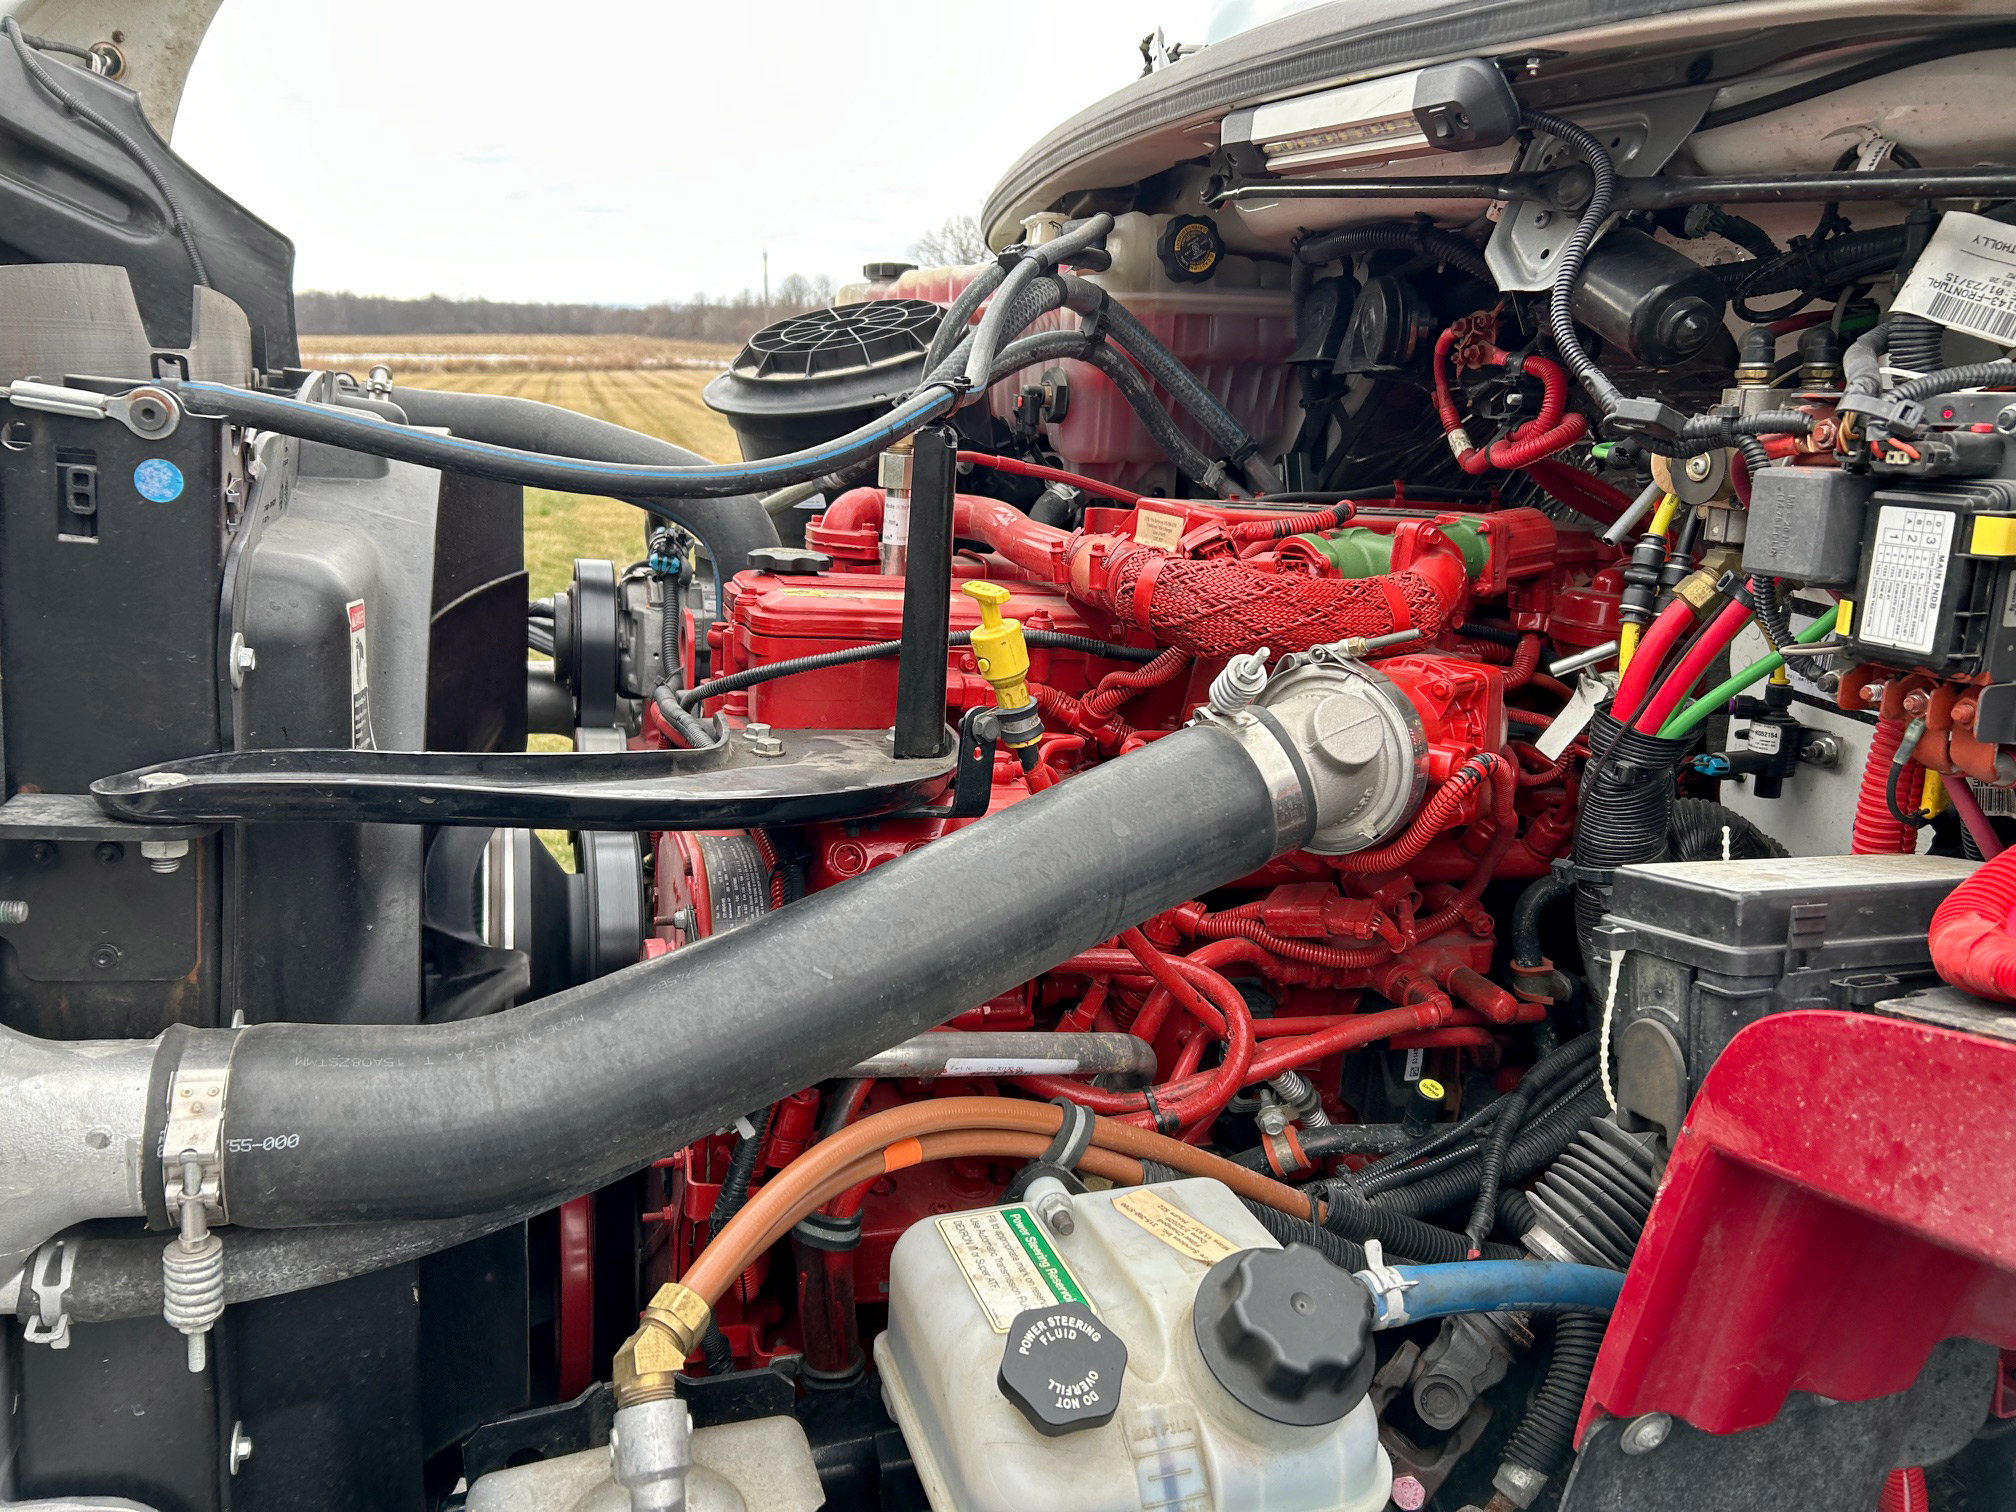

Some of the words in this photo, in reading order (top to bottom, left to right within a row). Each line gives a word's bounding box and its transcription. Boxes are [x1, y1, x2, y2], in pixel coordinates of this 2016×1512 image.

[1907, 534, 1918, 543] 2
[1926, 536, 1937, 545] 3
[1935, 555, 1945, 579] MAIN
[1930, 583, 1940, 609] PNDB
[544, 1014, 585, 1034] MADE
[514, 1031, 534, 1043] IN
[448, 1041, 507, 1060] U.S.A.
[225, 1134, 300, 1153] 55-000
[1156, 1217, 1185, 1237] Changed
[1169, 1211, 1189, 1225] Hours
[1172, 1235, 1200, 1255] Services
[1183, 1235, 1202, 1248] Filter
[1189, 1231, 1207, 1244] Done
[1213, 1238, 1231, 1251] Miles
[953, 1220, 975, 1245] DEXRON
[975, 1258, 991, 1277] Super
[969, 1217, 980, 1228] Use
[975, 1229, 998, 1258] Automatic
[993, 1257, 1021, 1296] Transmission
[986, 1214, 997, 1225] Fill
[994, 1229, 1020, 1262] appropriate
[1015, 1261, 1030, 1277] mark
[1025, 1277, 1035, 1287] on
[1009, 1212, 1033, 1237] Power
[1024, 1235, 1053, 1268] Steering
[1045, 1267, 1077, 1303] Reservoi
[1019, 1321, 1047, 1355] POWER
[1047, 1316, 1101, 1342] STEERING
[1039, 1328, 1077, 1346] FLUID
[1048, 1370, 1099, 1396] OVERFILL
[1055, 1397, 1080, 1409] NOT
[1083, 1390, 1100, 1405] DO
